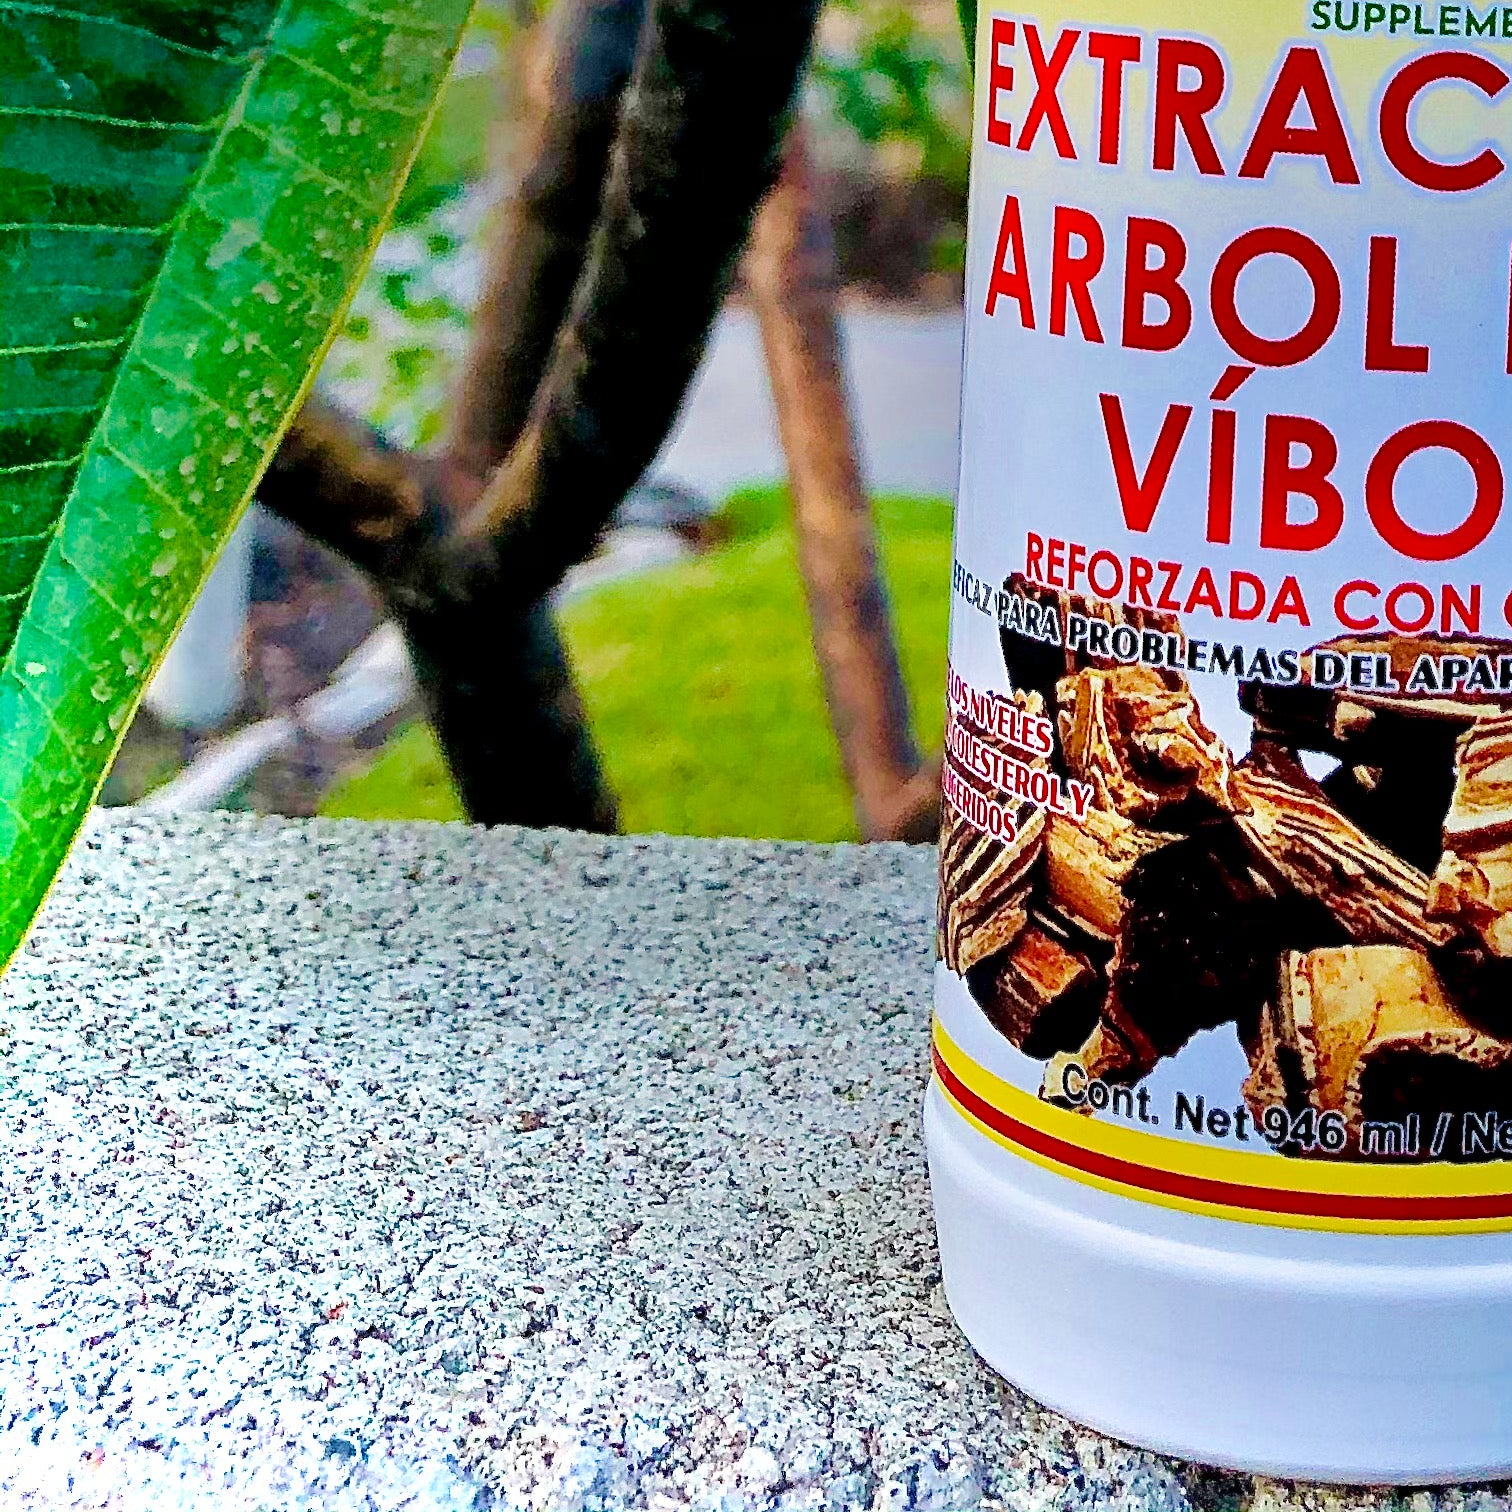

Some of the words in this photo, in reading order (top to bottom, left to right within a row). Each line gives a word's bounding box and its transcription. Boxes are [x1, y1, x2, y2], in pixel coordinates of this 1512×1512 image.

[985, 194, 1430, 374] ARBOL
[1026, 531, 1311, 628] REFORZADA
[1333, 578, 1482, 634] CON
[997, 591, 1061, 644] PARA
[1068, 614, 1300, 685] PROBLEMAS
[1314, 651, 1398, 690] DEL
[952, 722, 1065, 811] COLESTEROL
[1070, 783, 1091, 816] Y
[970, 688, 1052, 754] NIVELES
[1062, 1062, 1159, 1125] Cont.
[1175, 1091, 1250, 1142] Net
[1264, 1106, 1346, 1152] 946
[1360, 1112, 1419, 1156] ml
[1430, 1112, 1454, 1156] /
